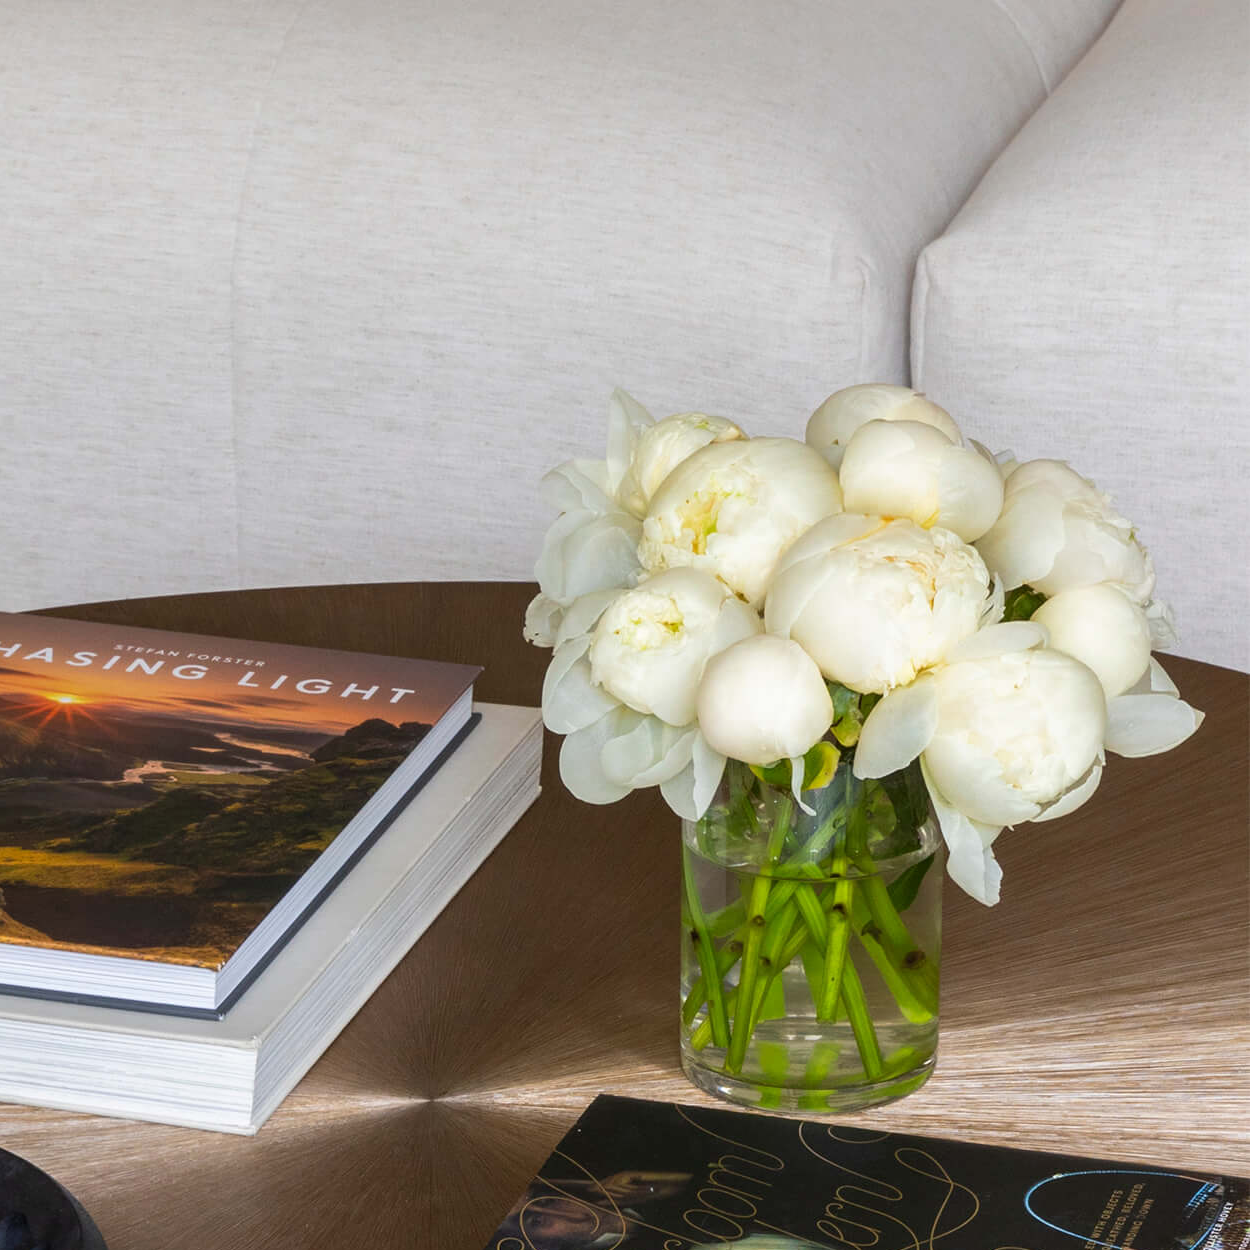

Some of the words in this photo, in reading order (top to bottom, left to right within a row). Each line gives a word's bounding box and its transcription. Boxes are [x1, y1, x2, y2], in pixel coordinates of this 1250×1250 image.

[113, 644, 180, 657] STEFAN
[186, 652, 266, 667] FORSTER
[237, 671, 416, 704] LIGHT
[1101, 1189, 1124, 1220] OBJECTS
